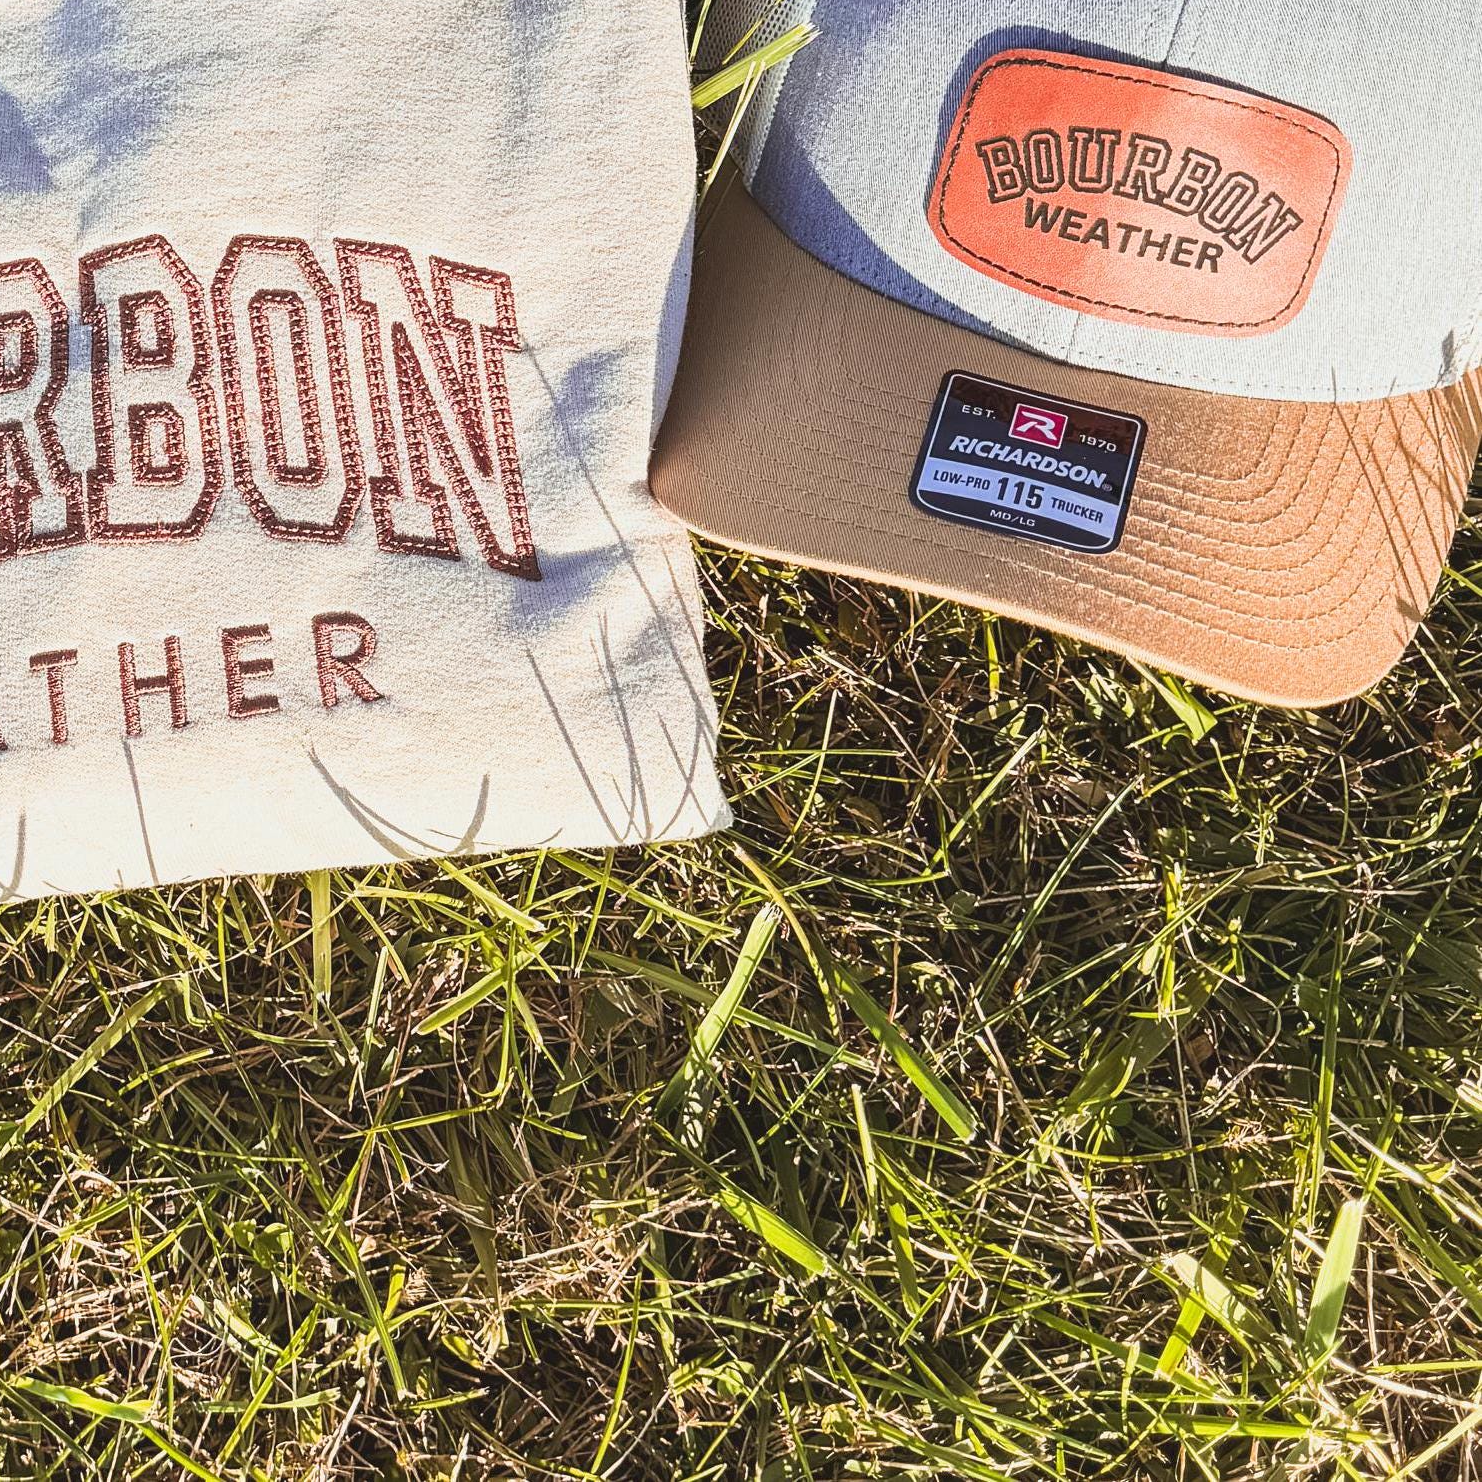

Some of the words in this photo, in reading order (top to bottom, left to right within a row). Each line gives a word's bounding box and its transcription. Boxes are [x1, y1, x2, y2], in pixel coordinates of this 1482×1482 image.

[976, 126, 1303, 264] BOURBON
[1023, 197, 1223, 273] WEATHER
[961, 404, 996, 419] EST.
[1079, 434, 1117, 453] 1970
[949, 435, 1108, 489] RICHARDSON
[933, 470, 991, 491] LOW-PRO
[997, 476, 1045, 510] 115
[1051, 497, 1104, 524] TRUCKER
[990, 509, 1036, 527] MD/LG
